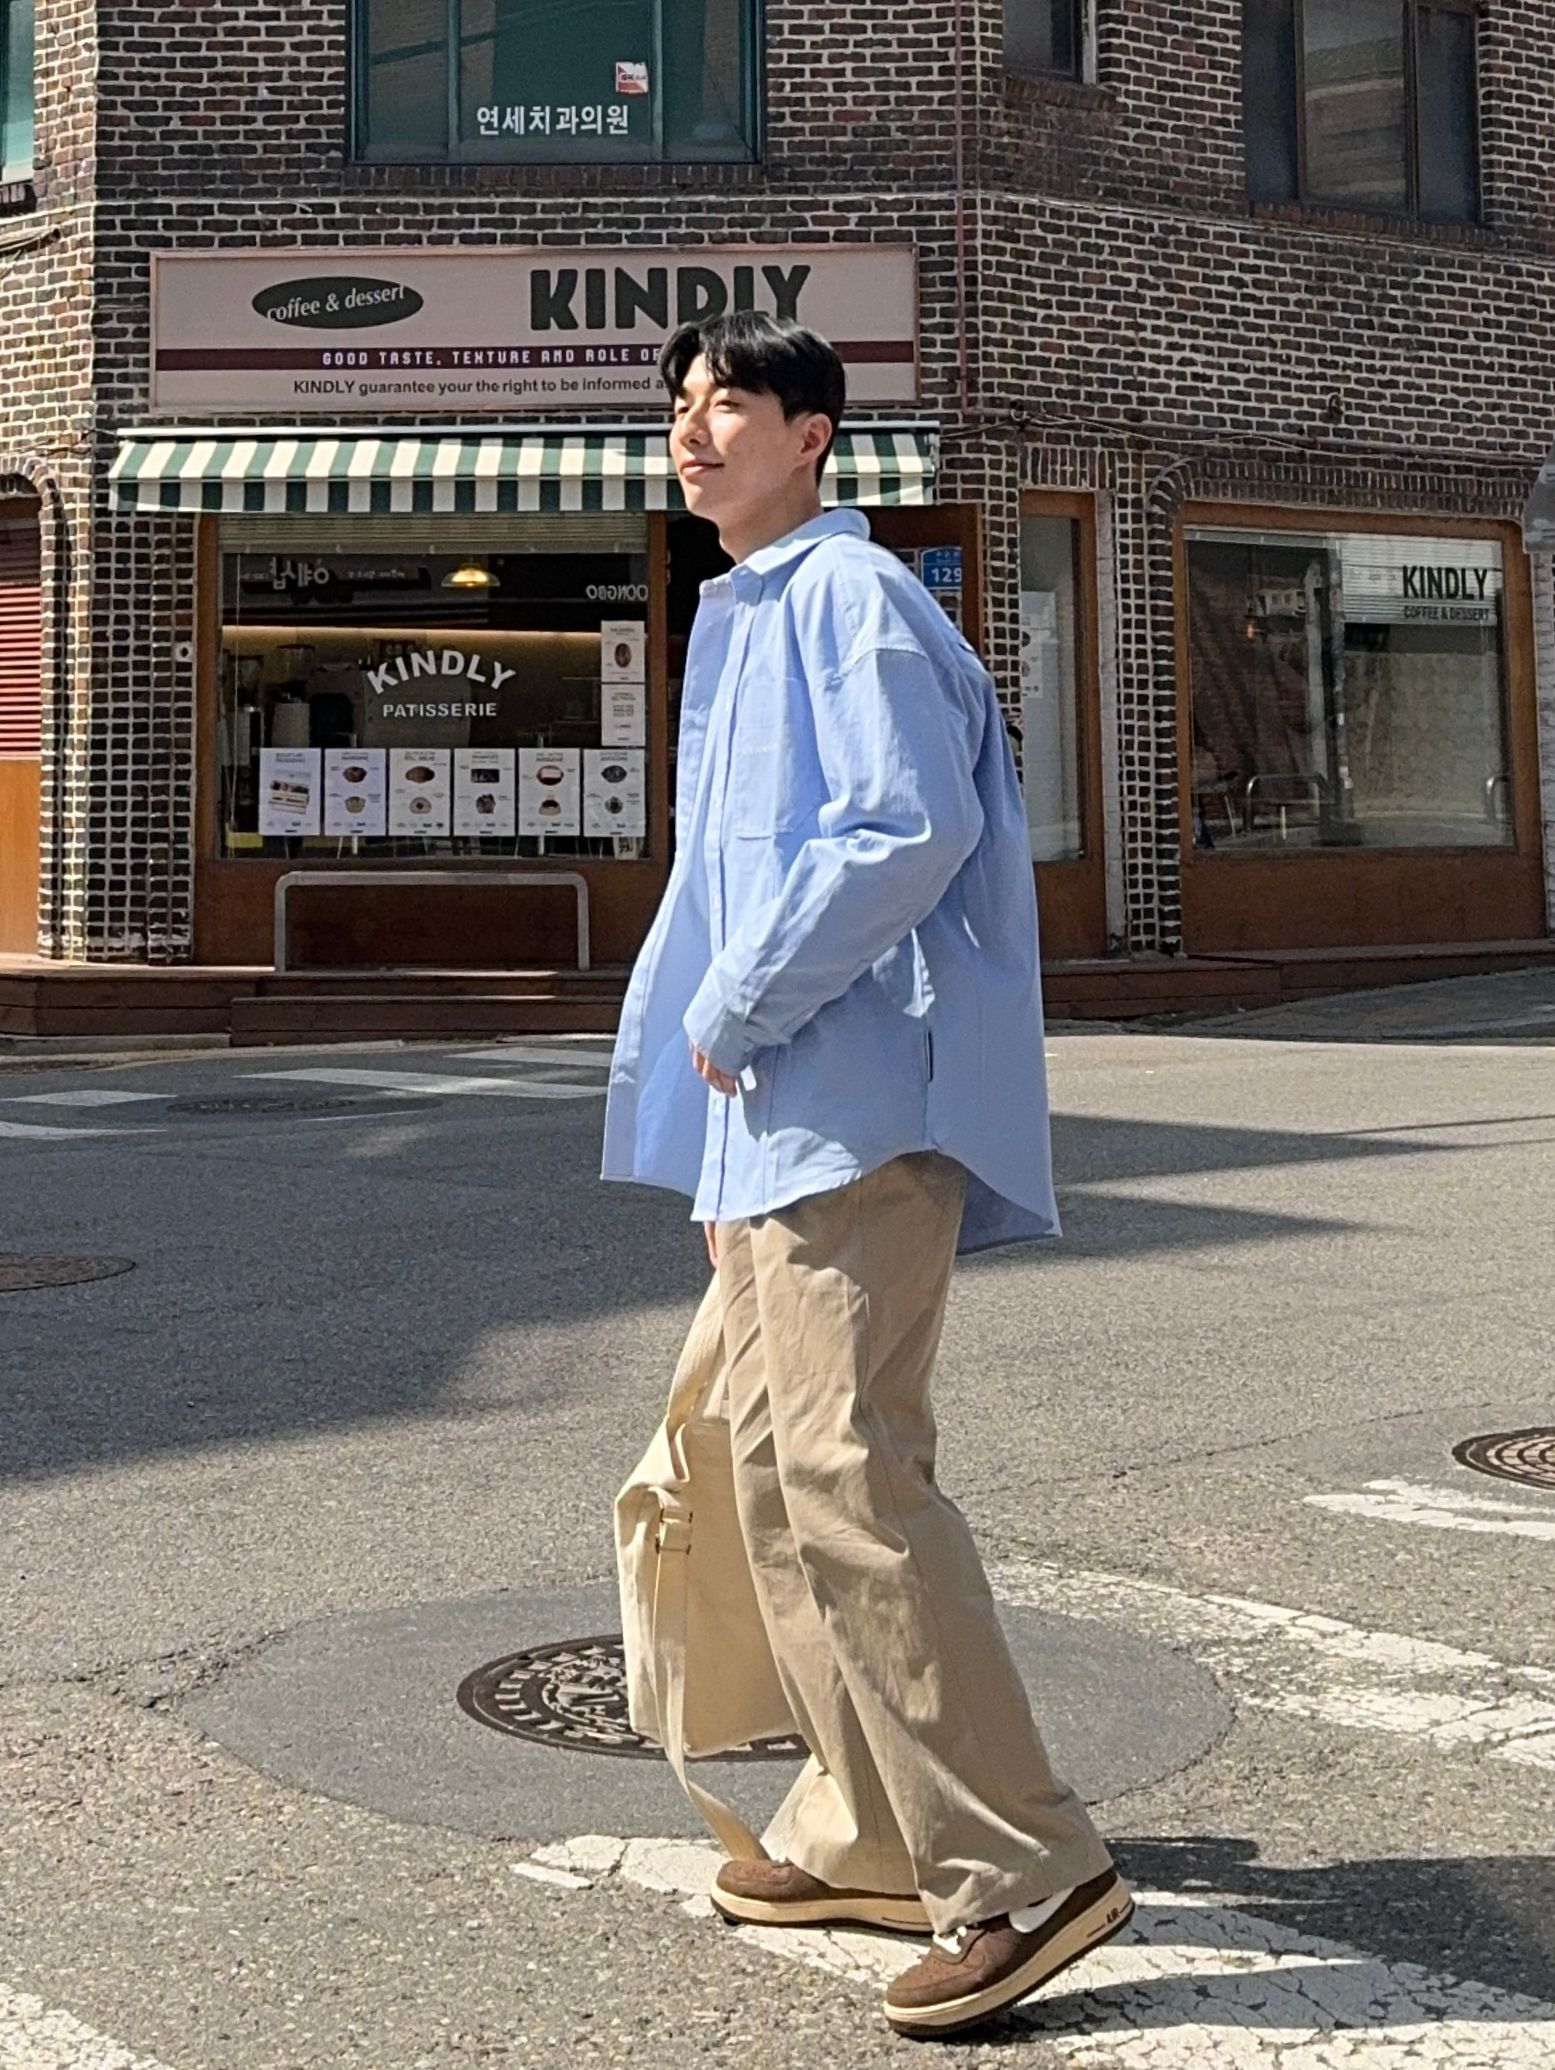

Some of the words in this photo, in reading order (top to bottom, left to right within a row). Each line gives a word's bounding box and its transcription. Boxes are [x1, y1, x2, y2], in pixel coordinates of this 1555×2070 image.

[476, 104, 628, 135] 연세치과의원
[266, 297, 320, 321] coffee
[325, 293, 339, 312] &
[345, 284, 405, 309] dessert
[322, 352, 368, 365] GOOD
[452, 350, 530, 365] TEXTURE
[541, 350, 575, 364] AND
[586, 348, 630, 363] ROLE
[294, 380, 355, 394] KINDLY
[359, 380, 435, 396] guarantee
[438, 382, 473, 396] your
[476, 379, 499, 393] the
[502, 379, 538, 395] right
[541, 379, 557, 391] to
[561, 378, 578, 391] be
[583, 377, 651, 391] informed
[931, 567, 962, 583] 129
[1402, 565, 1487, 600] KINDLY
[1403, 605, 1439, 620] COFFEE
[1450, 608, 1490, 621] DESSERT
[366, 650, 517, 695] KINDLY
[382, 702, 497, 718] PATISSERIE
